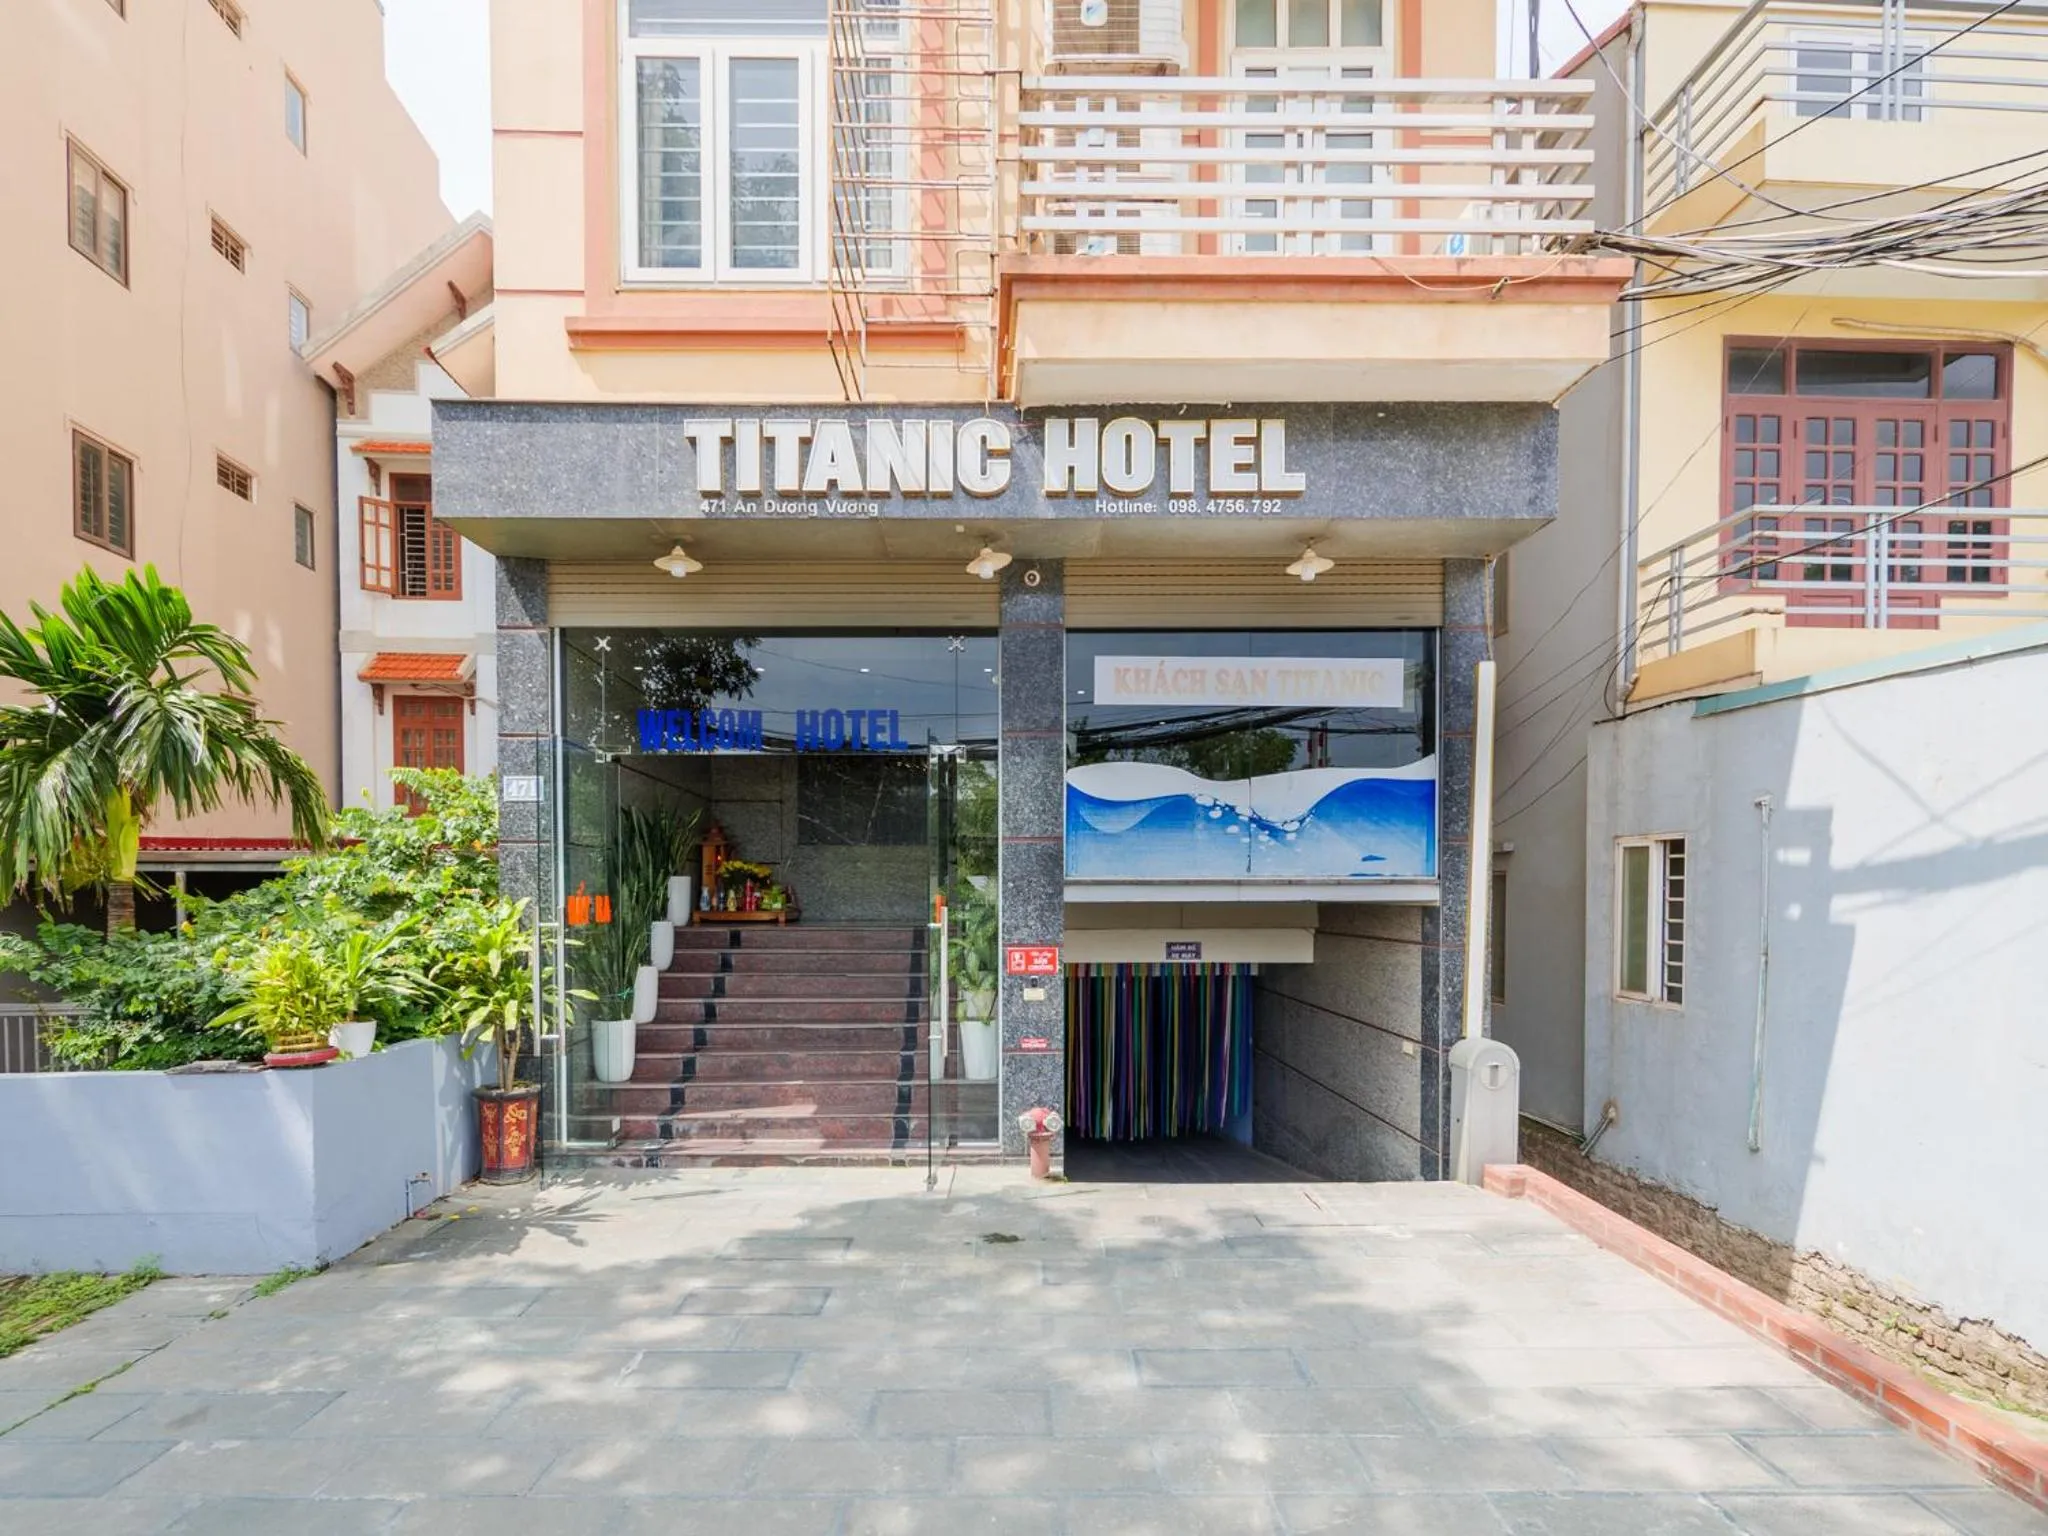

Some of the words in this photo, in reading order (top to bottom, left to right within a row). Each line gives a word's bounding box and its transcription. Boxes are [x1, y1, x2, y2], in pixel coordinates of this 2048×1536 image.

[684, 418, 1012, 497] TITANIC
[1043, 418, 1306, 497] HOTEL
[700, 499, 726, 514] 471
[733, 500, 756, 513] An
[764, 500, 817, 516] Dương
[825, 500, 879, 517] Vương
[1095, 499, 1157, 514] Hotline:
[1168, 499, 1201, 513] 098.
[1206, 499, 1282, 514] 4756.792
[1113, 661, 1208, 694] KHÁCH
[1276, 669, 1384, 697] TITANIC
[637, 708, 763, 752] WELCOM
[796, 707, 908, 752] HOTEL
